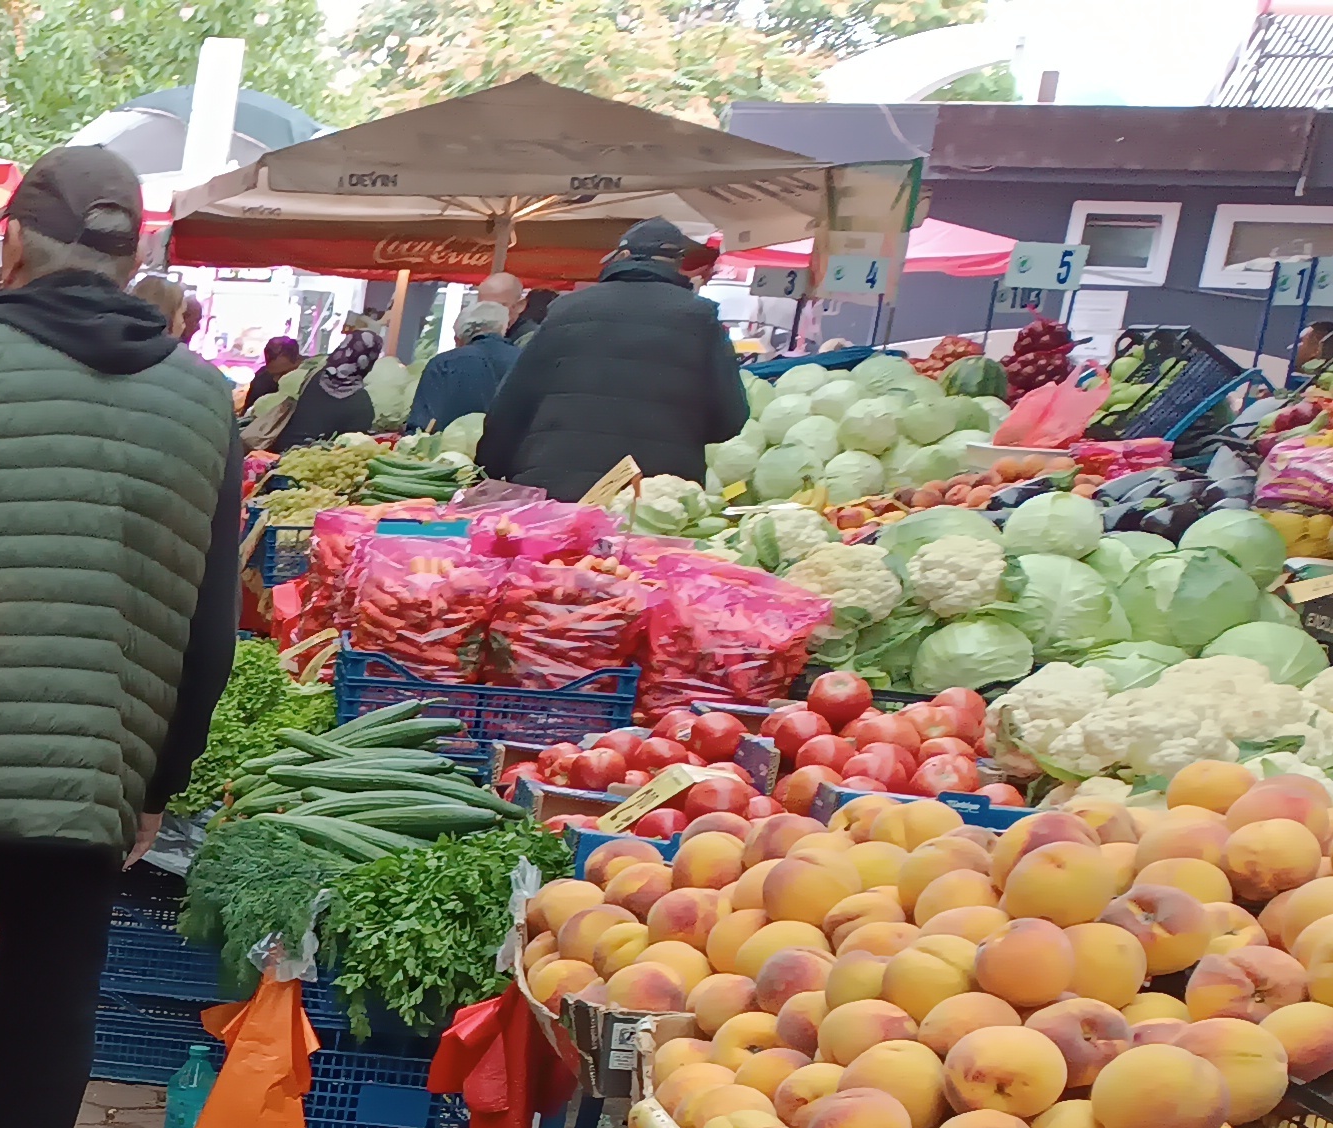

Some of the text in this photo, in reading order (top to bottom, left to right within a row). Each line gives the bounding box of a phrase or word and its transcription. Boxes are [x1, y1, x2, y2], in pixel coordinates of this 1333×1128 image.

[348, 172, 398, 188] DEVIN
[569, 174, 622, 191] DEVIN
[865, 260, 879, 289] 4
[1056, 250, 1078, 285] 5
[784, 270, 799, 296] 3
